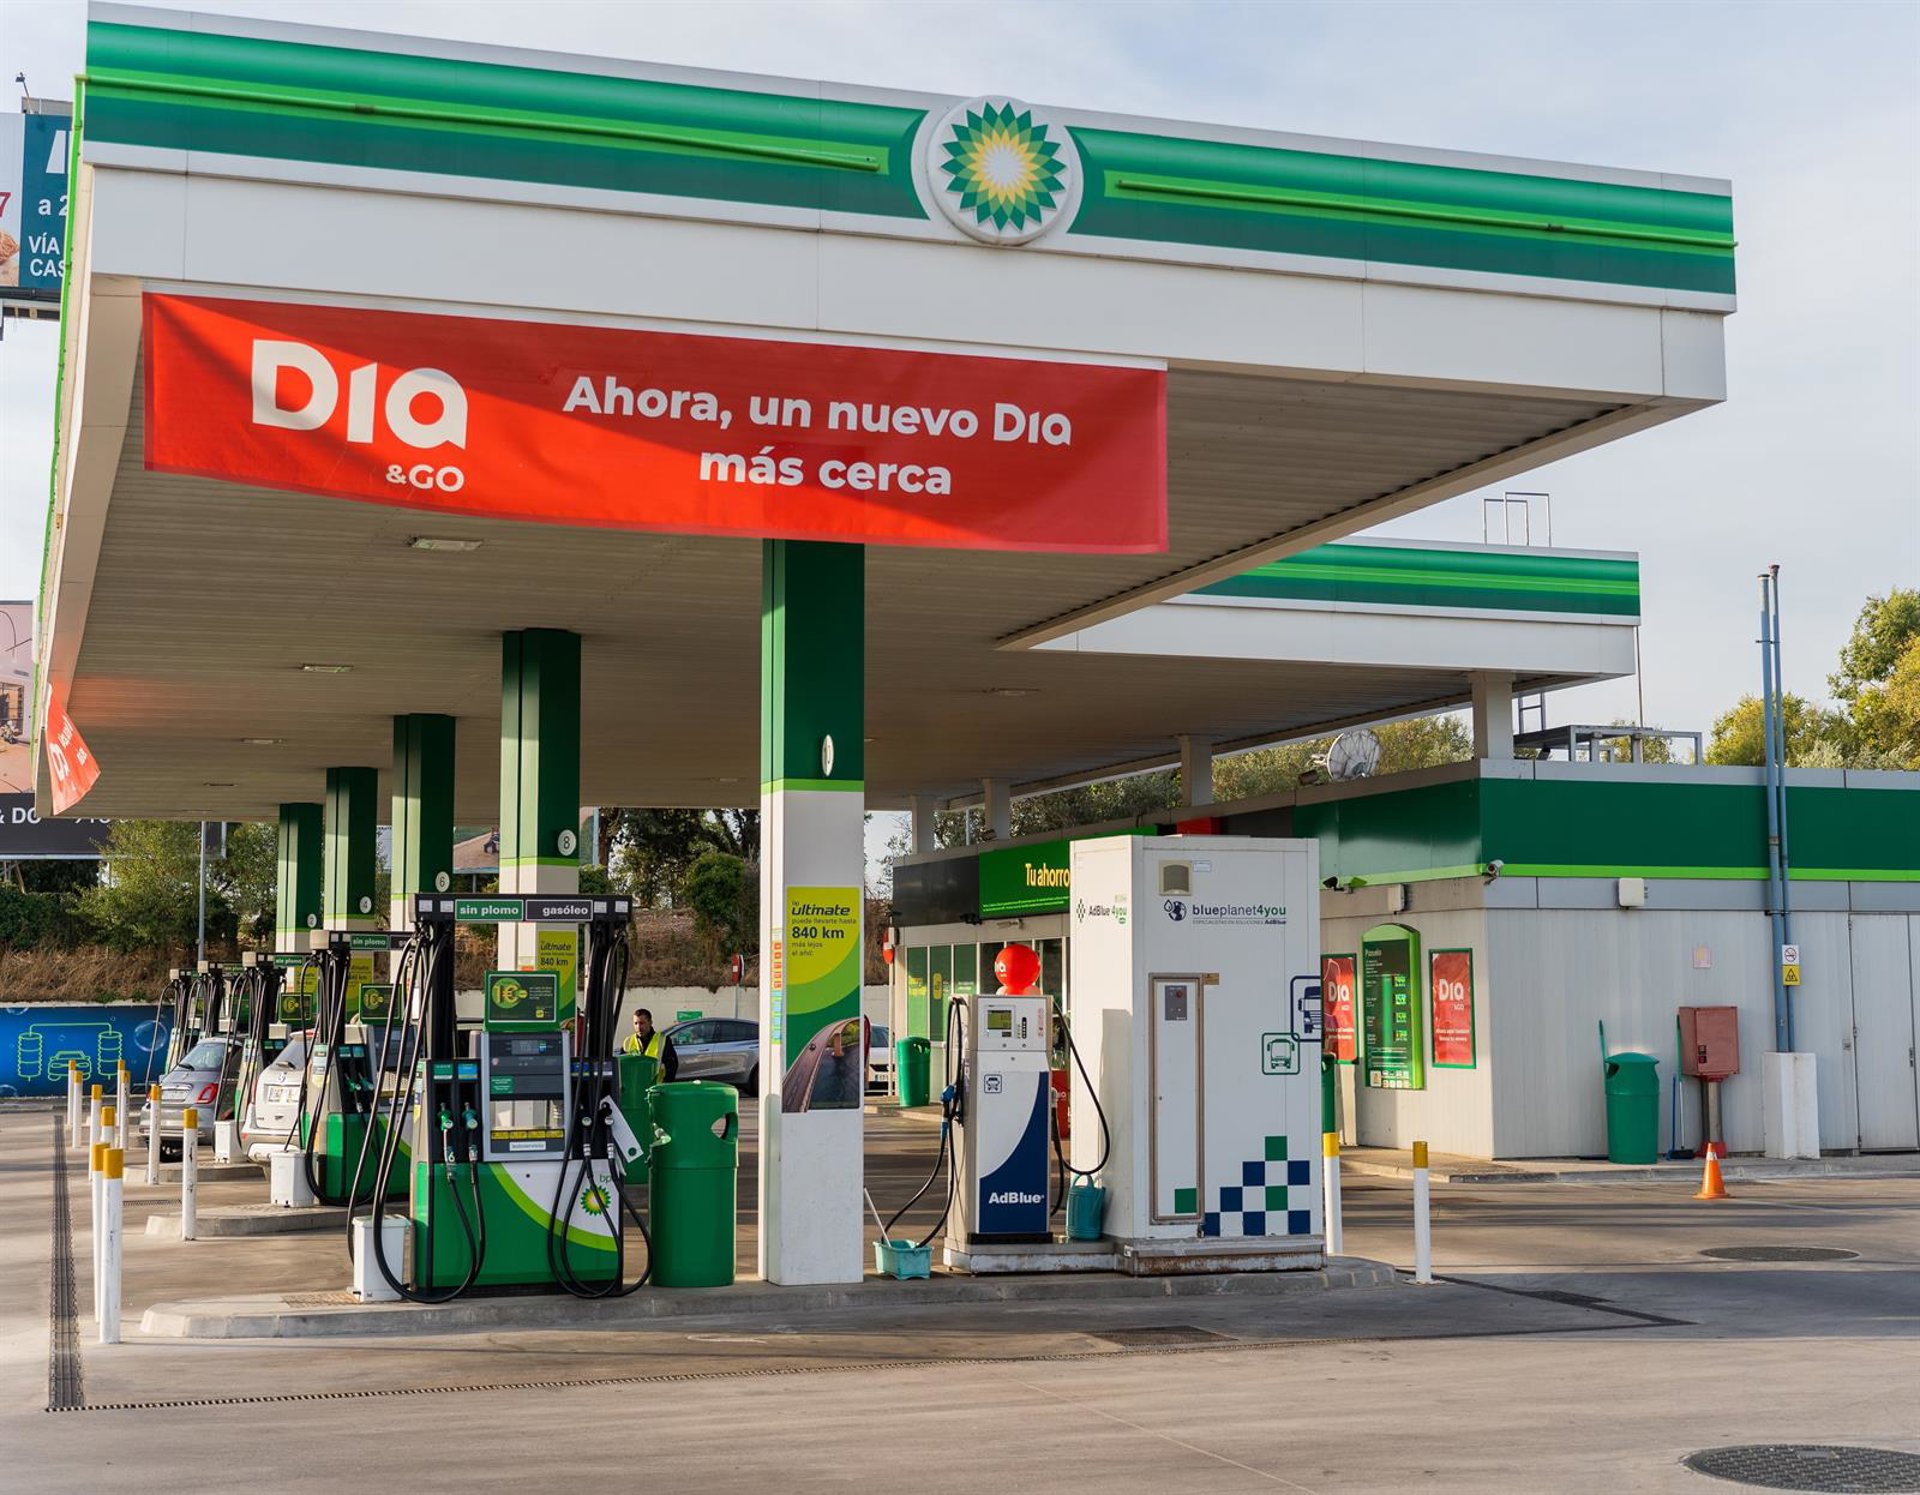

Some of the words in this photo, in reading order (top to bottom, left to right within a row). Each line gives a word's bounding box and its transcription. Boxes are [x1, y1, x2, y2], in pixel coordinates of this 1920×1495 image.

[38, 200, 51, 216] a
[28, 233, 60, 254] VÍA
[562, 376, 733, 430] Ahora,
[750, 396, 811, 427] un
[828, 401, 979, 438] nuevo
[700, 445, 803, 486] más
[818, 460, 951, 494] cerca
[386, 464, 464, 492] &GO
[563, 836, 570, 849] 8
[1025, 863, 1036, 886] Tu
[439, 877, 446, 888] 6
[460, 905, 478, 915] sin
[481, 905, 519, 917] plomo
[542, 905, 589, 917] gasóleo
[791, 904, 851, 916] ultimate
[1192, 904, 1286, 918] blueplanet4you
[791, 926, 818, 939] 840
[822, 926, 845, 939] km
[988, 1192, 1042, 1204] AdBlue
